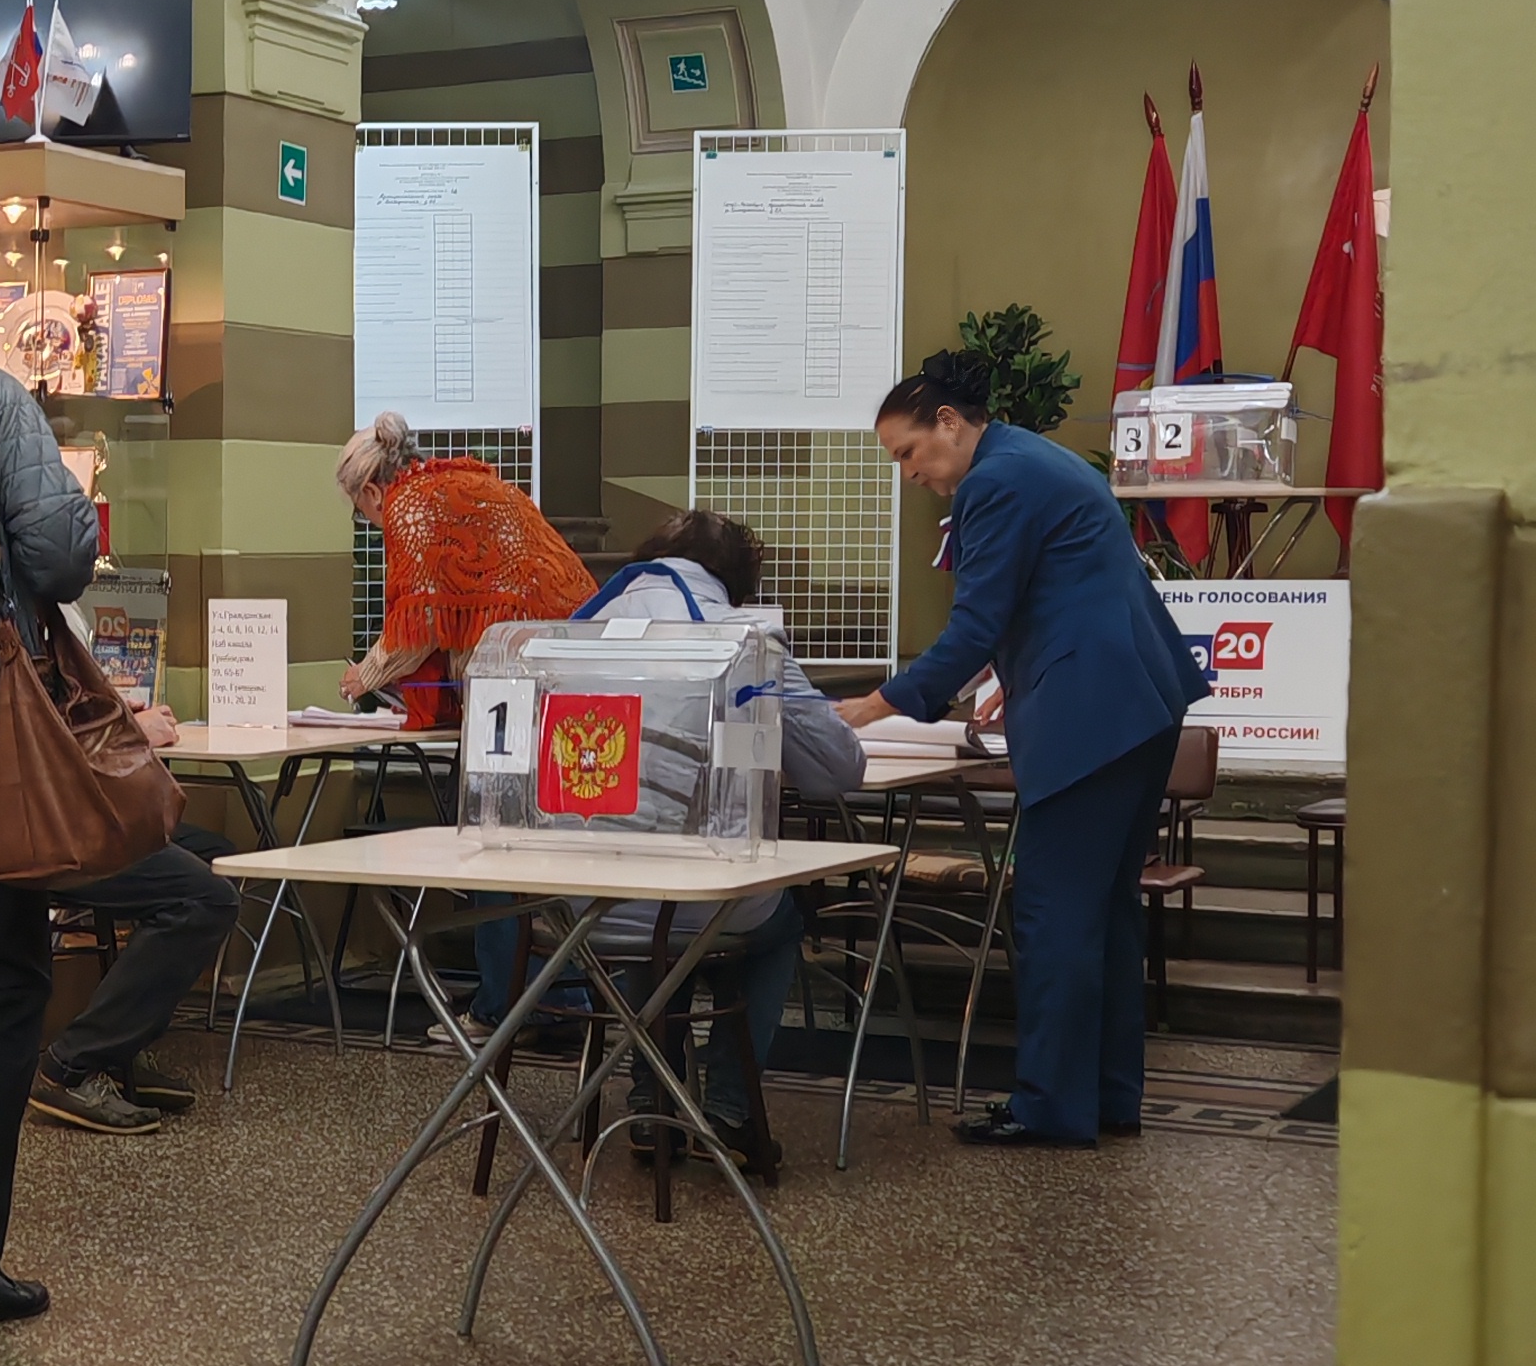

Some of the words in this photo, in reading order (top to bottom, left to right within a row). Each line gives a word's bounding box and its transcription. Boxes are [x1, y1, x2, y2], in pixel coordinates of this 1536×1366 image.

[1124, 427, 1142, 453] 3
[1164, 423, 1182, 449] 2
[1160, 591, 1194, 604] ЕНЬ
[1198, 591, 1327, 604] ГОЛОСОВАНИЯ
[1190, 645, 1209, 671] 9
[1216, 632, 1261, 660] 20
[1211, 687, 1263, 699] ТЯБРЯ
[485, 701, 513, 756] 1
[1242, 726, 1320, 740] РОССИИ!
